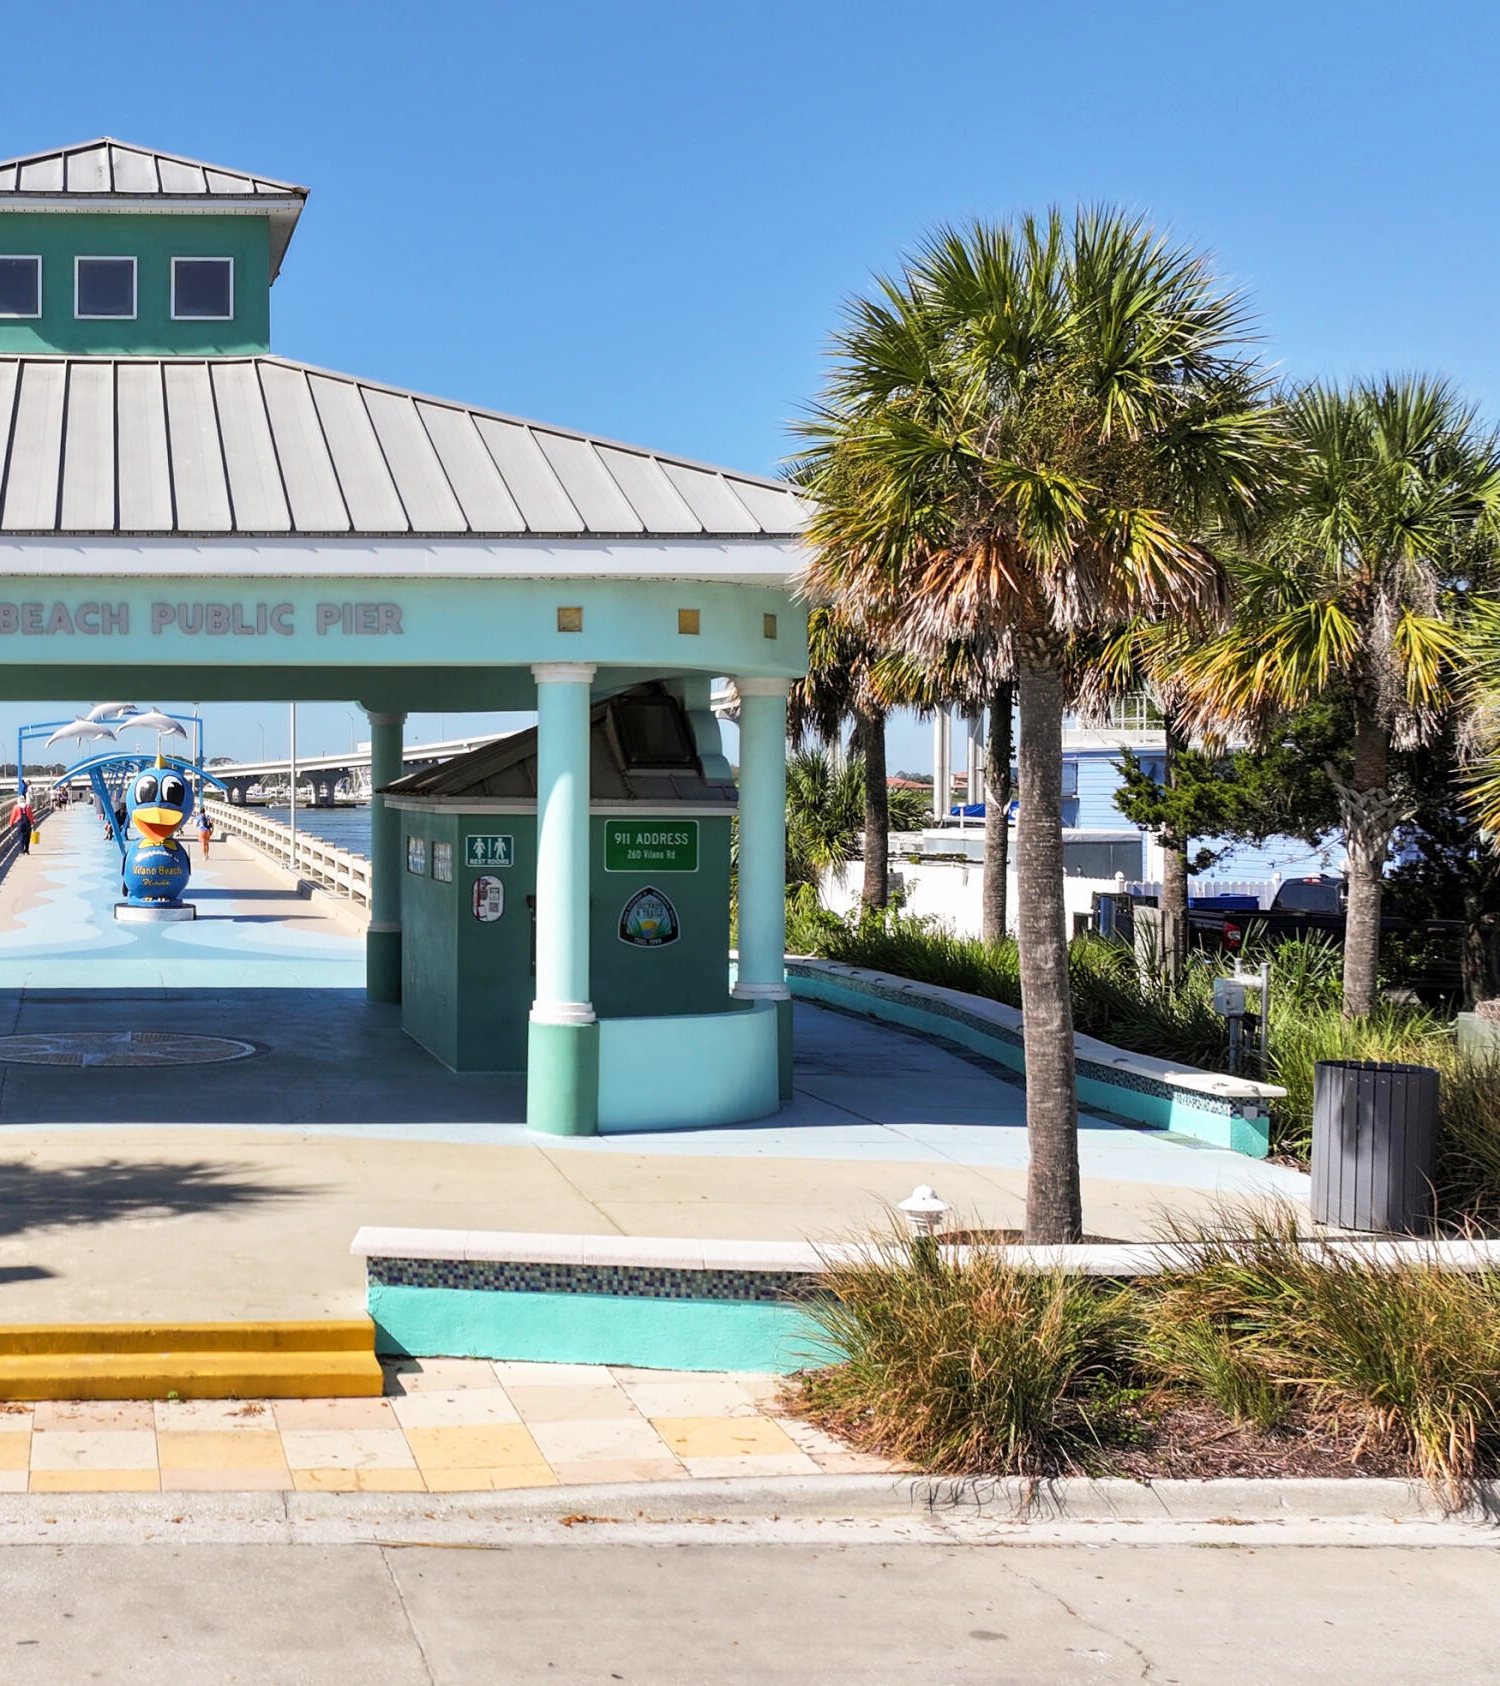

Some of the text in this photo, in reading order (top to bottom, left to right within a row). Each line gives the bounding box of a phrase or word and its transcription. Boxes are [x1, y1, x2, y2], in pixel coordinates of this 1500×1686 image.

[151, 602, 295, 636] PUBLIC
[316, 603, 404, 636] PIER
[614, 832, 689, 845] 911 ADDRESS
[643, 849, 665, 859] Vilano
[133, 865, 182, 875] Vilano Beach
